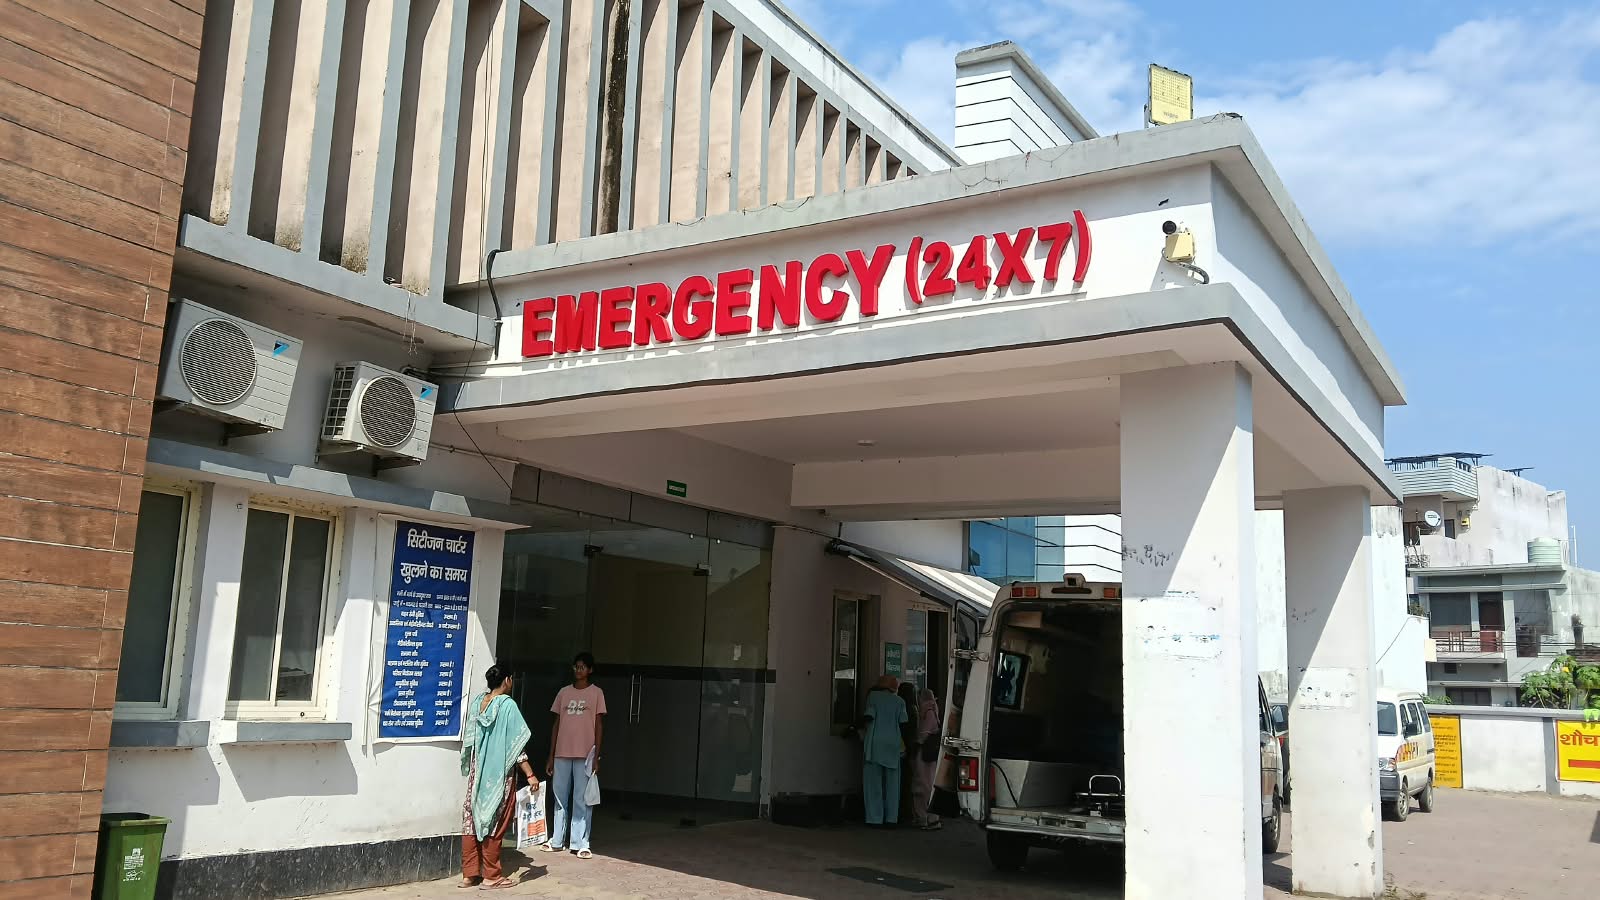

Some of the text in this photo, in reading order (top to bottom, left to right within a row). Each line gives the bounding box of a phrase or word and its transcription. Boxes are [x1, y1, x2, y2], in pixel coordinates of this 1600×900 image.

[522, 209, 1093, 358] EMERGENCY (24X7)
[407, 528, 468, 555] सिटीजन चार्टर
[400, 560, 468, 584] खुलने का समय
